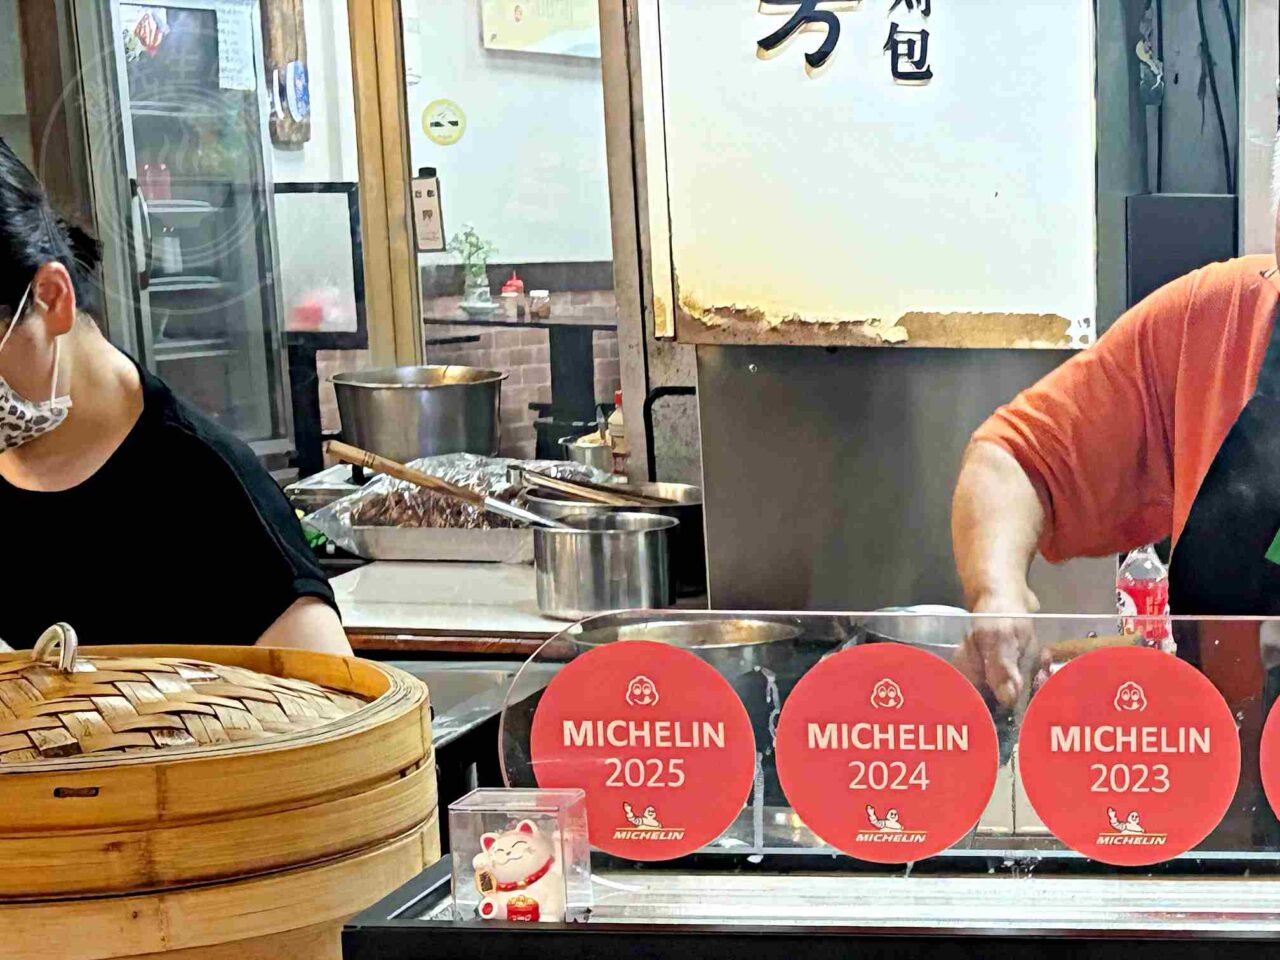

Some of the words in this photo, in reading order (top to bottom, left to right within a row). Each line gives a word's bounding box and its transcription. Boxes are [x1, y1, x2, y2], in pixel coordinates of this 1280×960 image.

[563, 720, 725, 748] MICHELIN
[808, 722, 969, 751] MICHELIN
[1050, 725, 1211, 753] MICHELIN
[604, 757, 685, 787] 2025
[848, 760, 930, 790] 2024
[1090, 763, 1170, 793] 2023
[613, 831, 686, 840] MICHELIN
[855, 833, 926, 843] MICHELIN
[1096, 836, 1168, 845] MICHELIN
